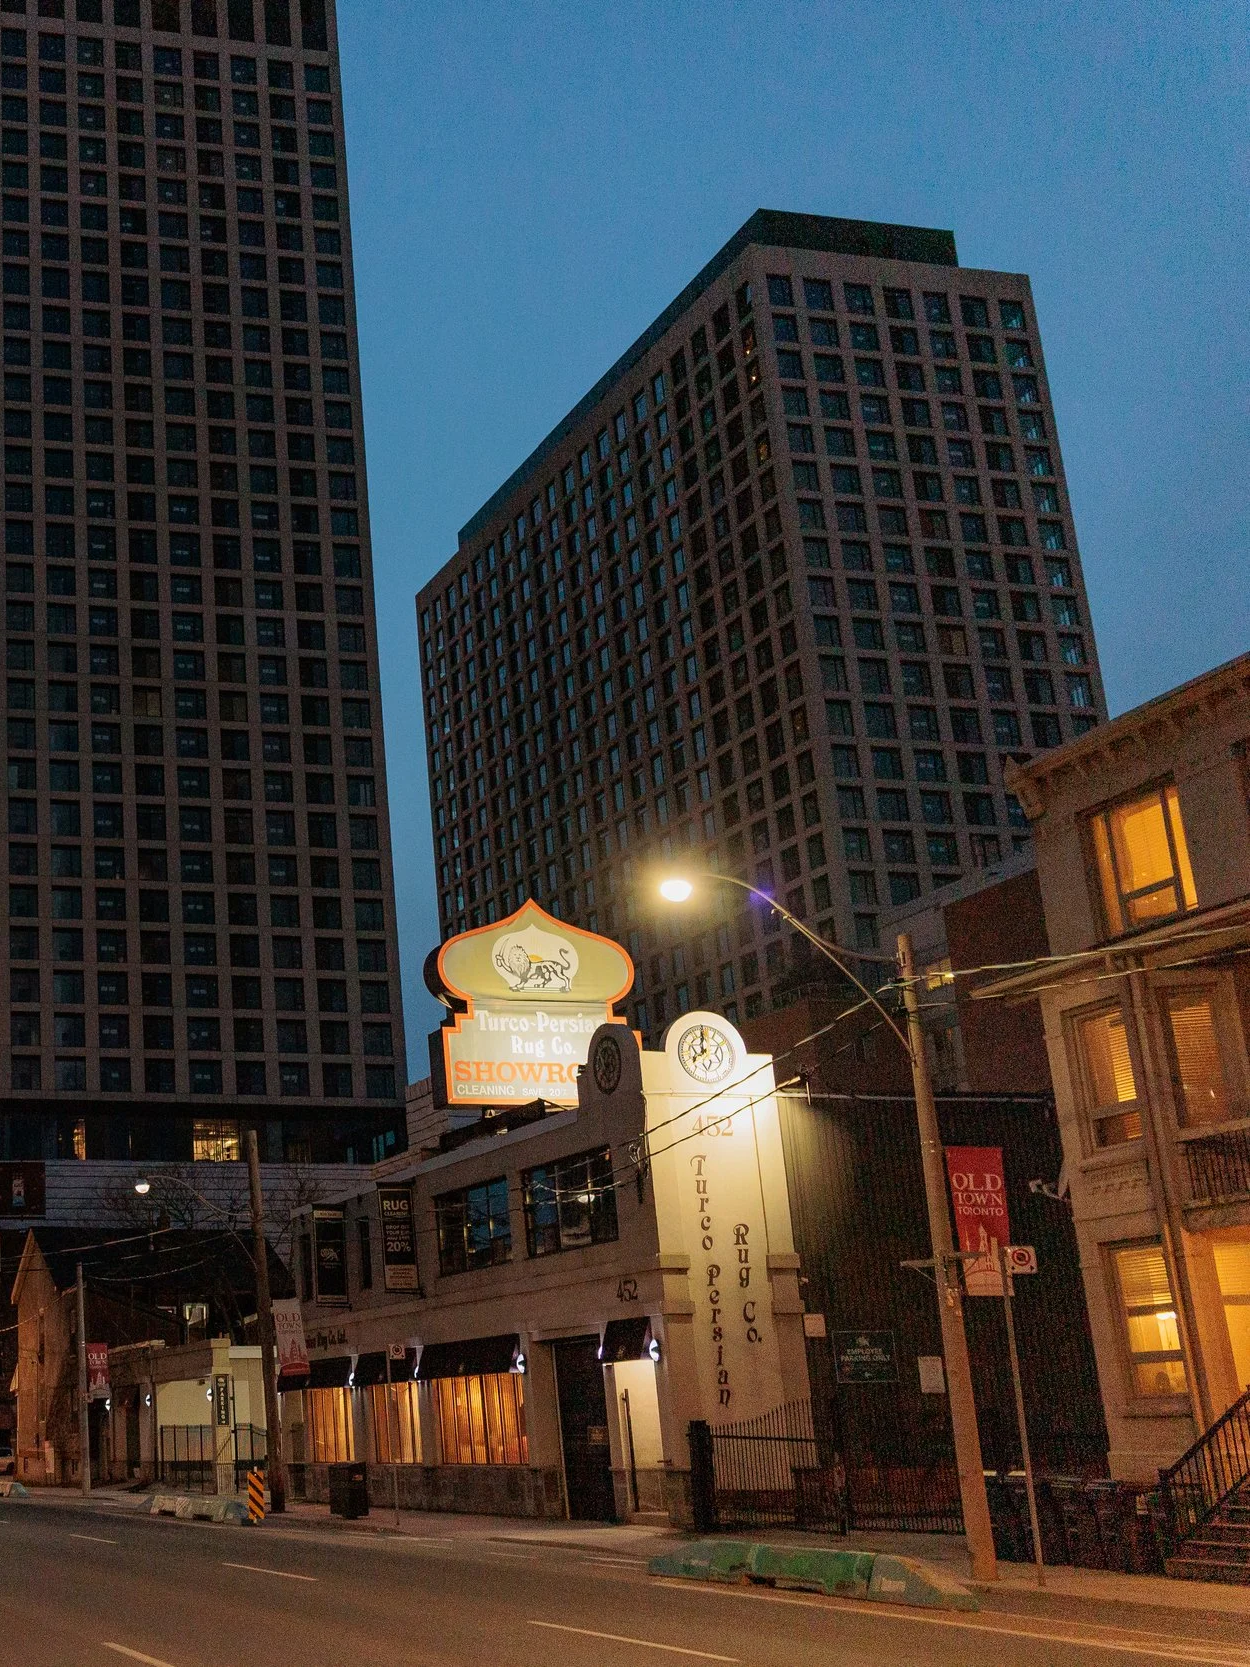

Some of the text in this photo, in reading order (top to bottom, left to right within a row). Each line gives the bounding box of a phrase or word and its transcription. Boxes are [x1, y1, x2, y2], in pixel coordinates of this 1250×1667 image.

[511, 1035, 576, 1058] Rug Co.
[456, 1084, 515, 1096] CLEANING
[522, 1087, 546, 1097] SAVE
[692, 1114, 734, 1138] 452
[952, 1173, 1002, 1191] OLD
[383, 1200, 409, 1211] RUG
[956, 1192, 1003, 1206] TOWN
[958, 1206, 1004, 1217] TORONTO
[386, 1241, 412, 1252] 20%
[689, 1154, 732, 1409] Turco Persian
[733, 1223, 763, 1345] Rug Co.
[616, 1279, 639, 1302] 452
[276, 1312, 301, 1323] OLD
[277, 1322, 302, 1330] TOWN
[87, 1352, 107, 1360] OLD
